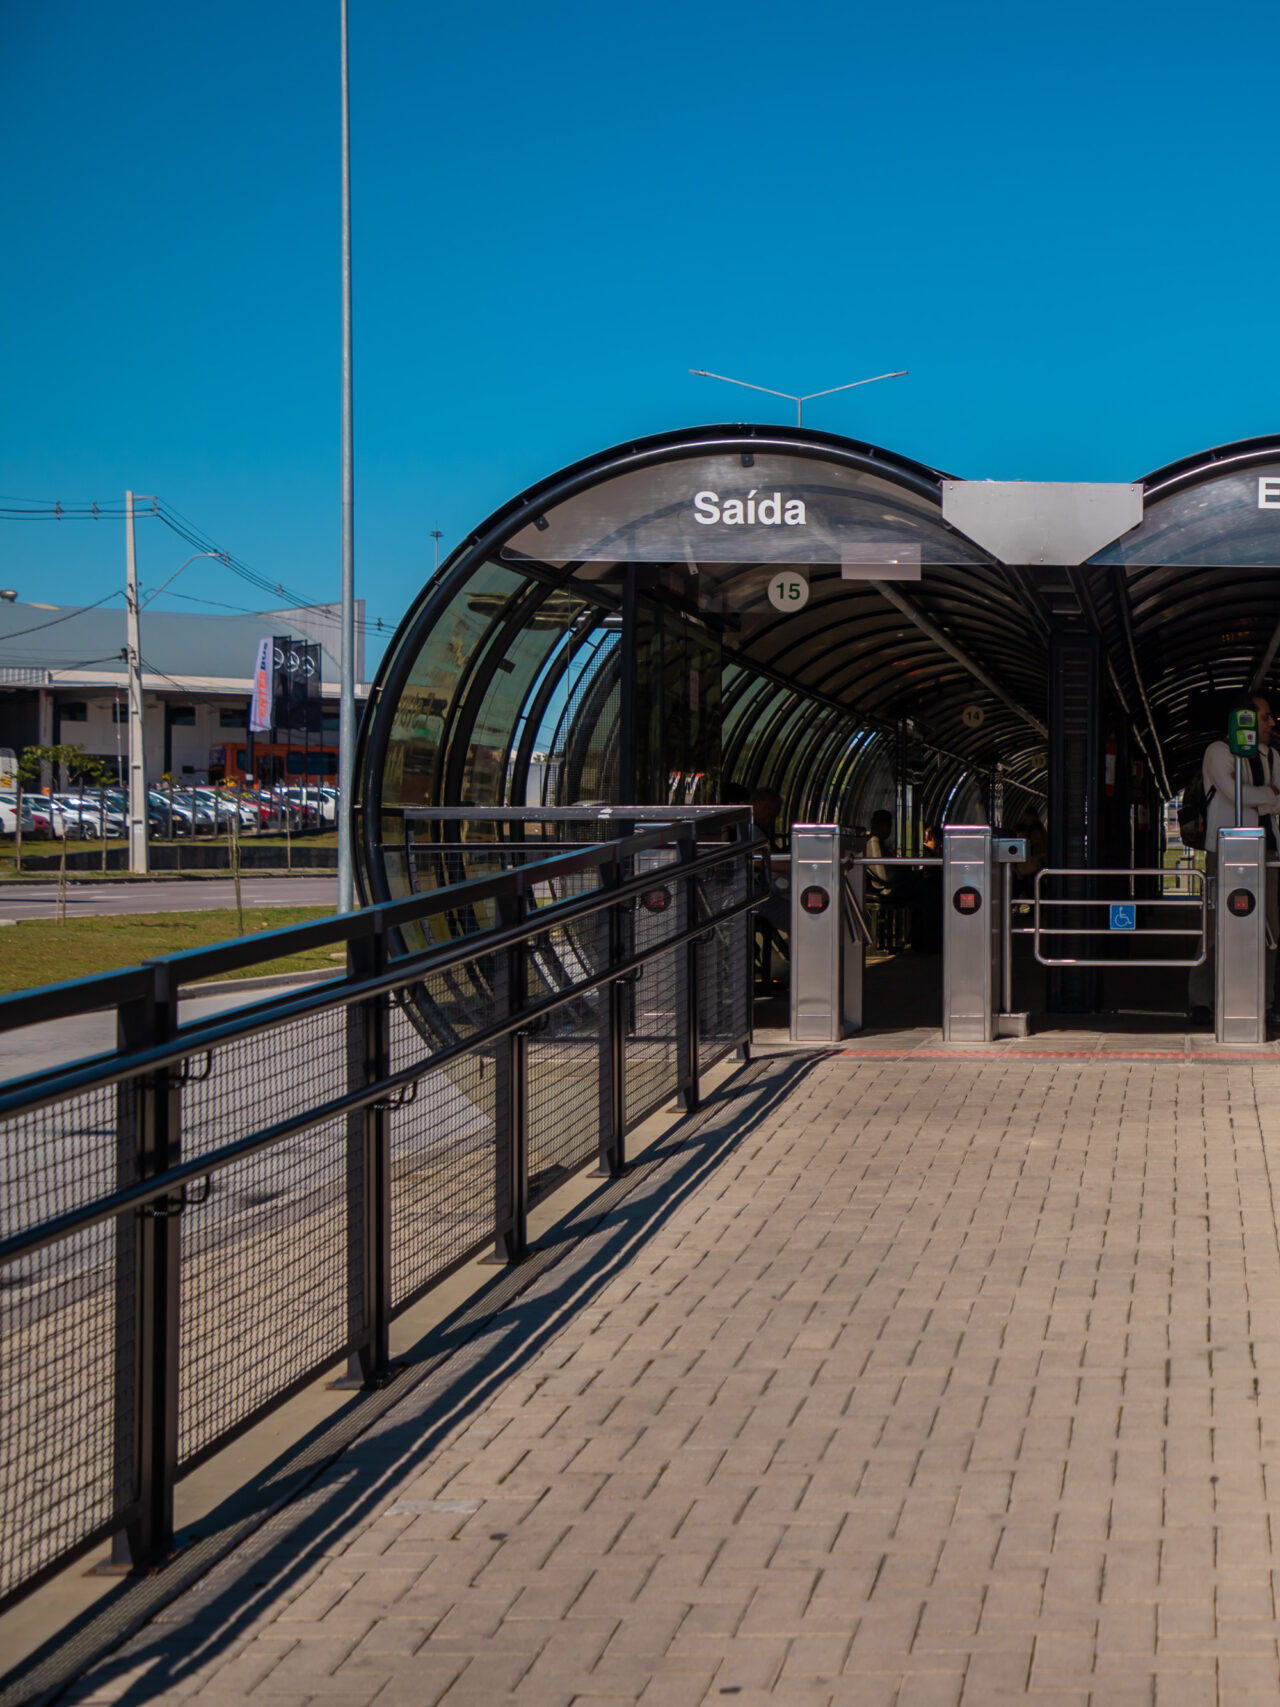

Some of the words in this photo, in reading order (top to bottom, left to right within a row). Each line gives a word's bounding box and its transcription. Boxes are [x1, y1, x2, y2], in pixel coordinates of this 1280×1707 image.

[694, 490, 807, 525] Saída
[776, 582, 801, 600] 15
[967, 711, 980, 720] 14
